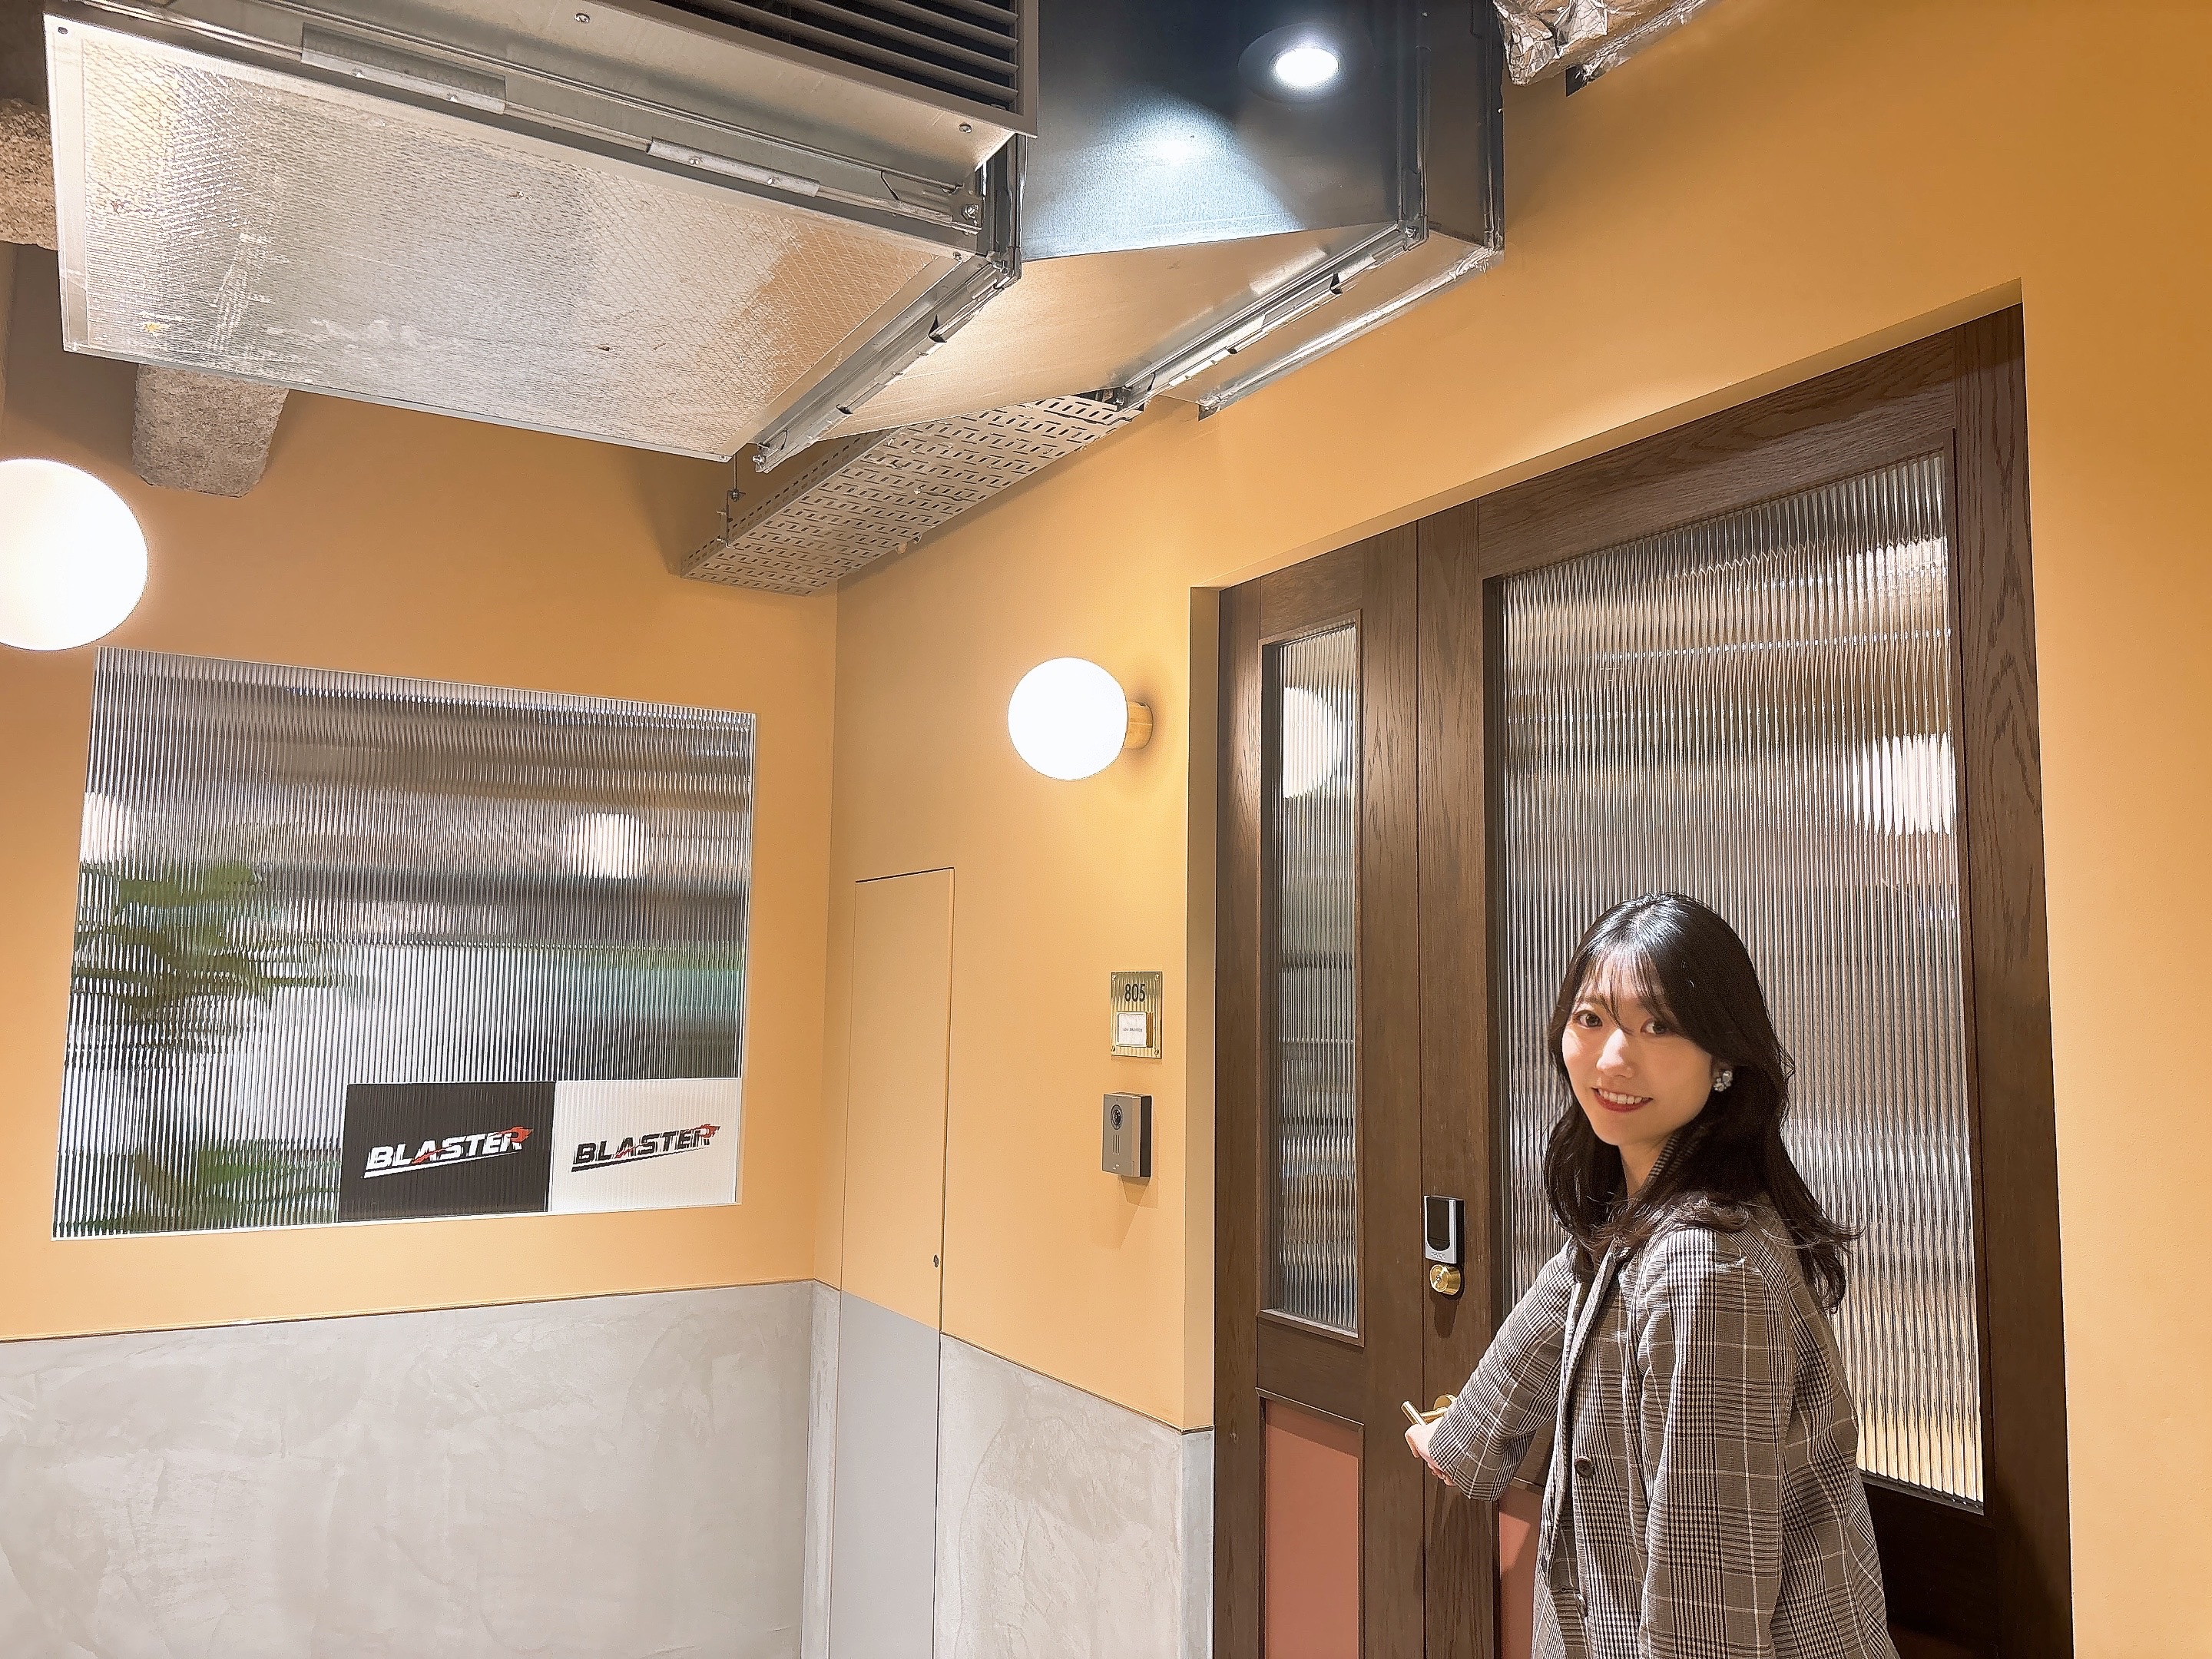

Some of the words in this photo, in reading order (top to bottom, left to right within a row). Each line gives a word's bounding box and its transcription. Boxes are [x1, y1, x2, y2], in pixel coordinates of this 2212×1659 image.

[1124, 983, 1146, 1002] 805
[365, 1126, 535, 1171] BLASTER
[575, 1125, 720, 1166] BLASTER
